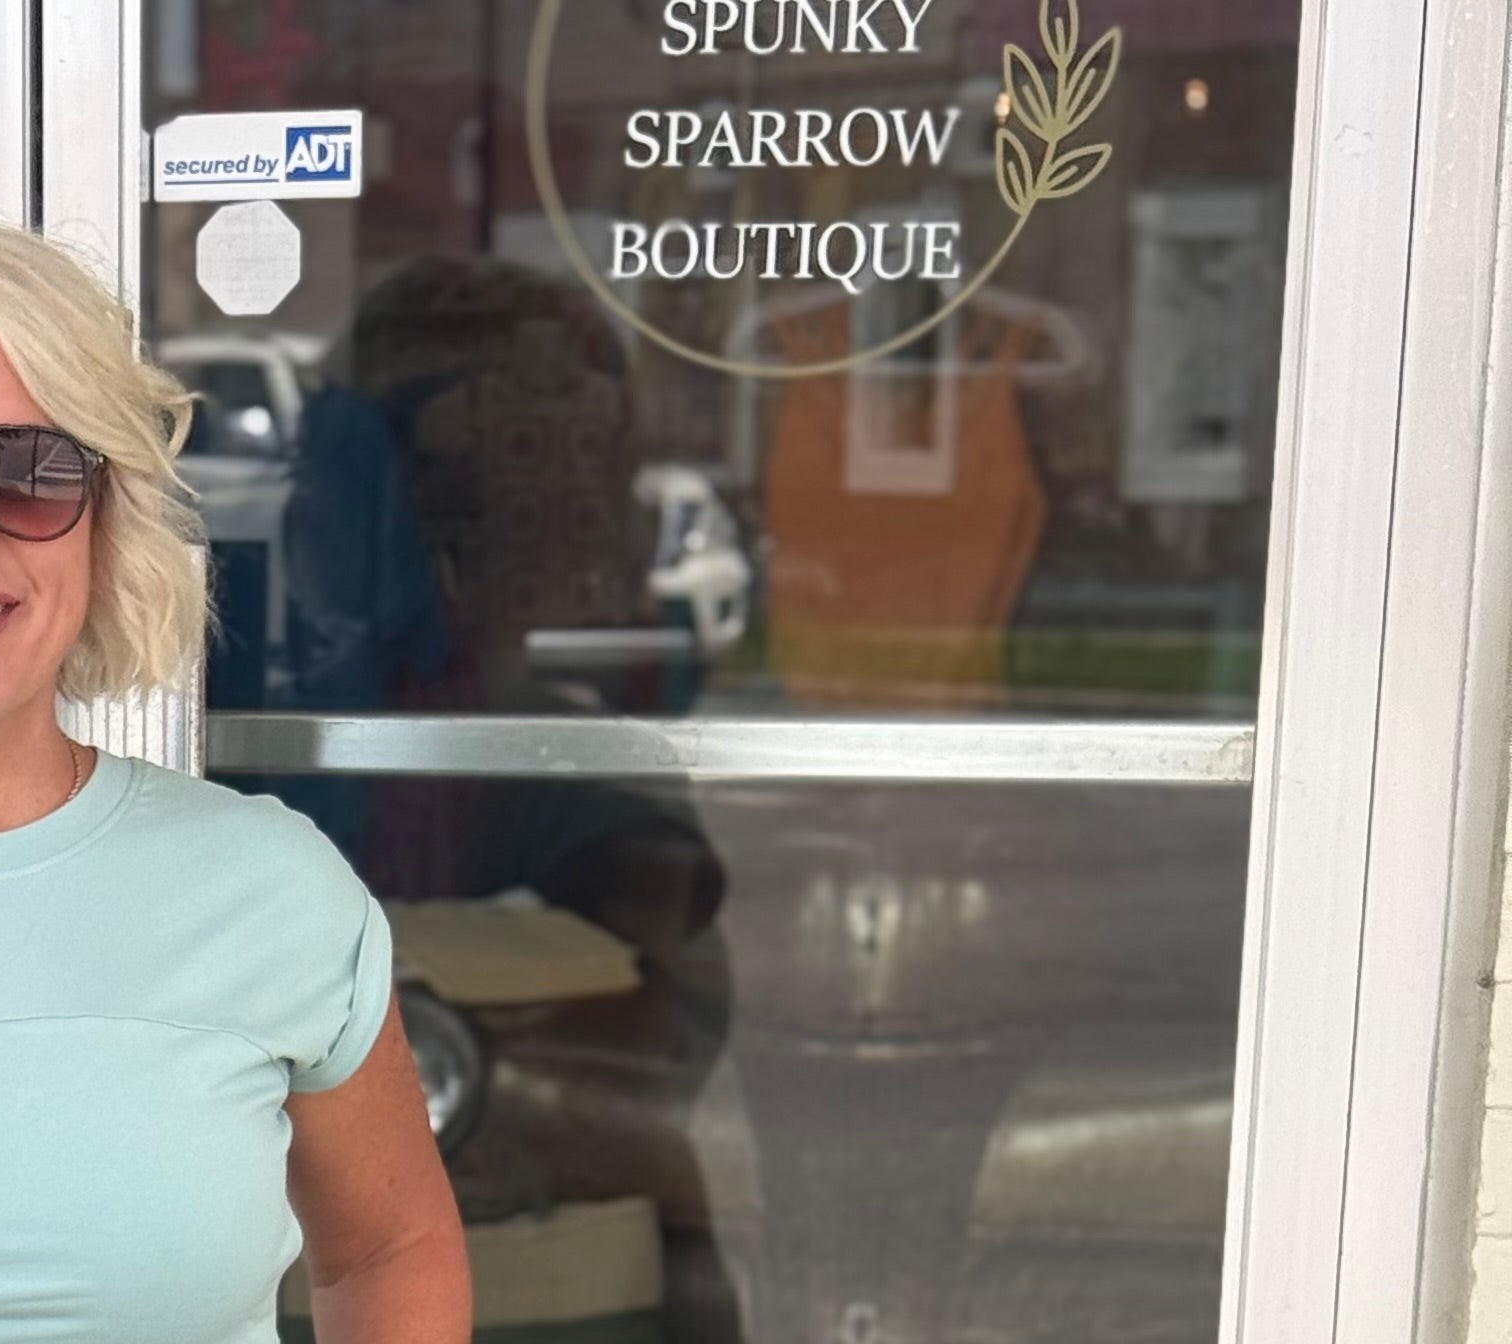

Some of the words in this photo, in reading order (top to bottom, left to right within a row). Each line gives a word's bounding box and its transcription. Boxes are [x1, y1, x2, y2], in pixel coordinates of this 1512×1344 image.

[661, 0, 933, 56] SPUNKY
[163, 154, 249, 175] secured
[253, 155, 279, 175] by
[285, 132, 352, 174] ADT
[624, 107, 959, 168] SPARROW
[611, 220, 961, 294] BOUTIQUE
